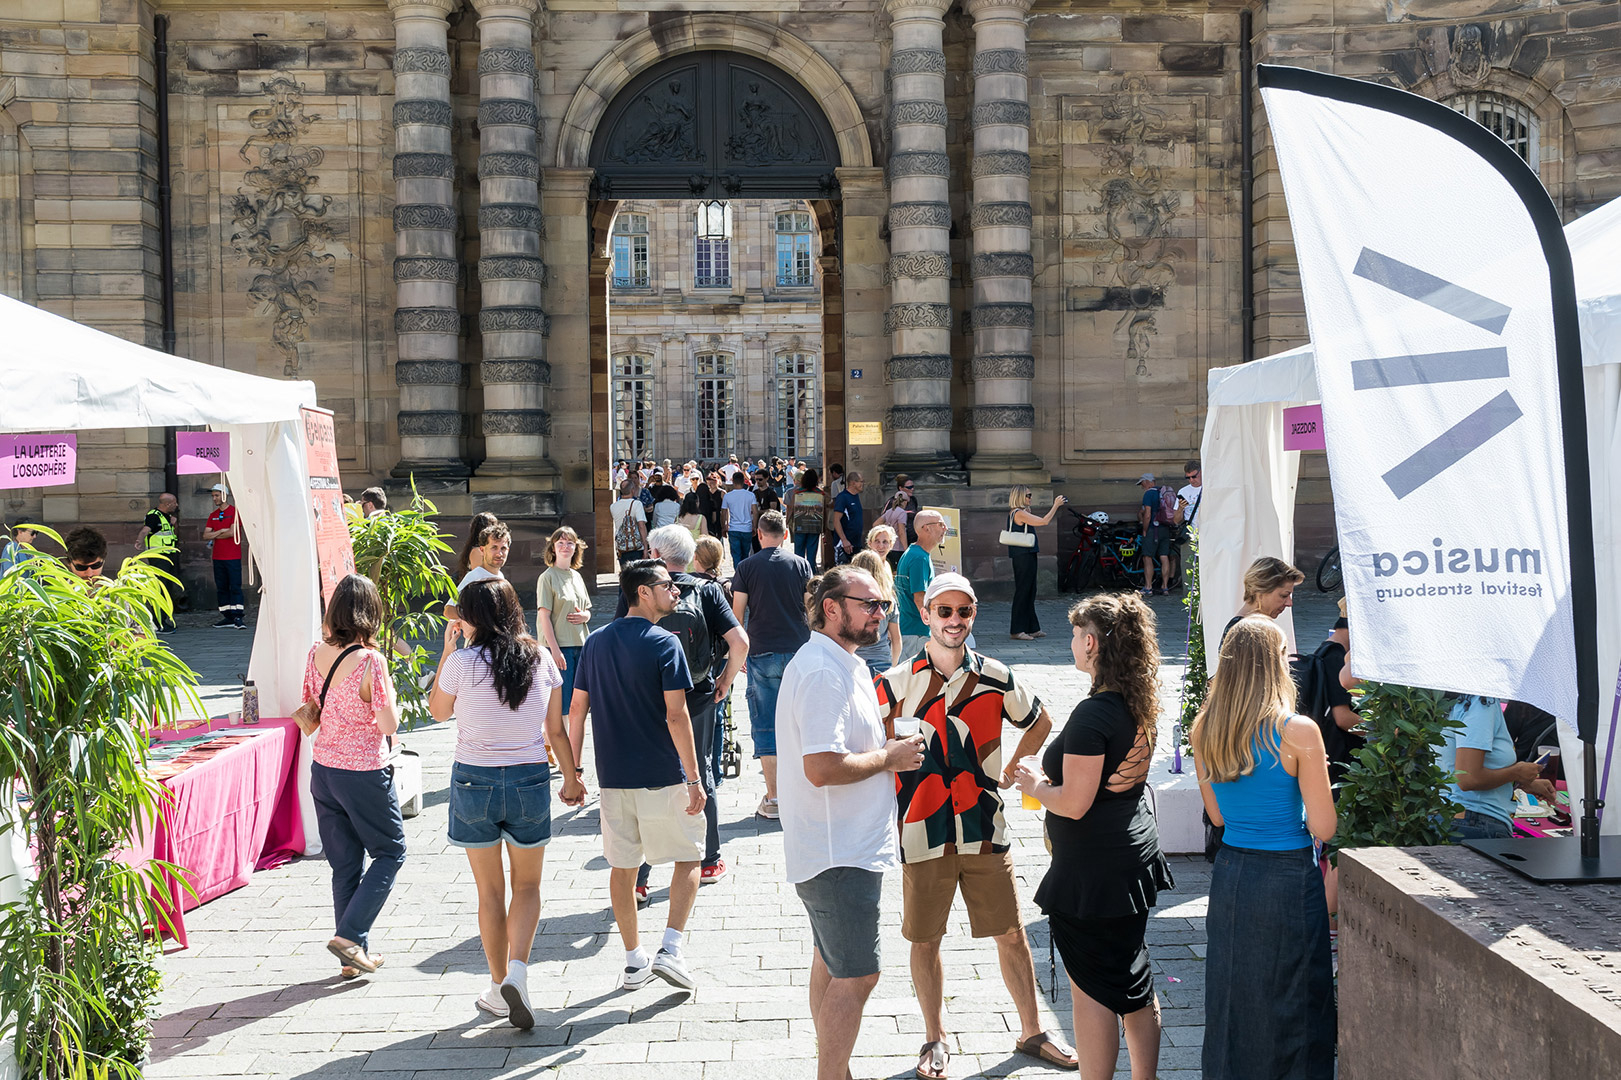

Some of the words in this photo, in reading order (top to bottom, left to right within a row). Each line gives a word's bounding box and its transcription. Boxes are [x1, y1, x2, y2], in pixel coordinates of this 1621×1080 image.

[853, 369, 860, 378] 2
[1291, 422, 1317, 435] JAZZDOR
[14, 445, 27, 459] LA
[28, 444, 67, 459] LAITERIE
[195, 447, 220, 458] PELPASS
